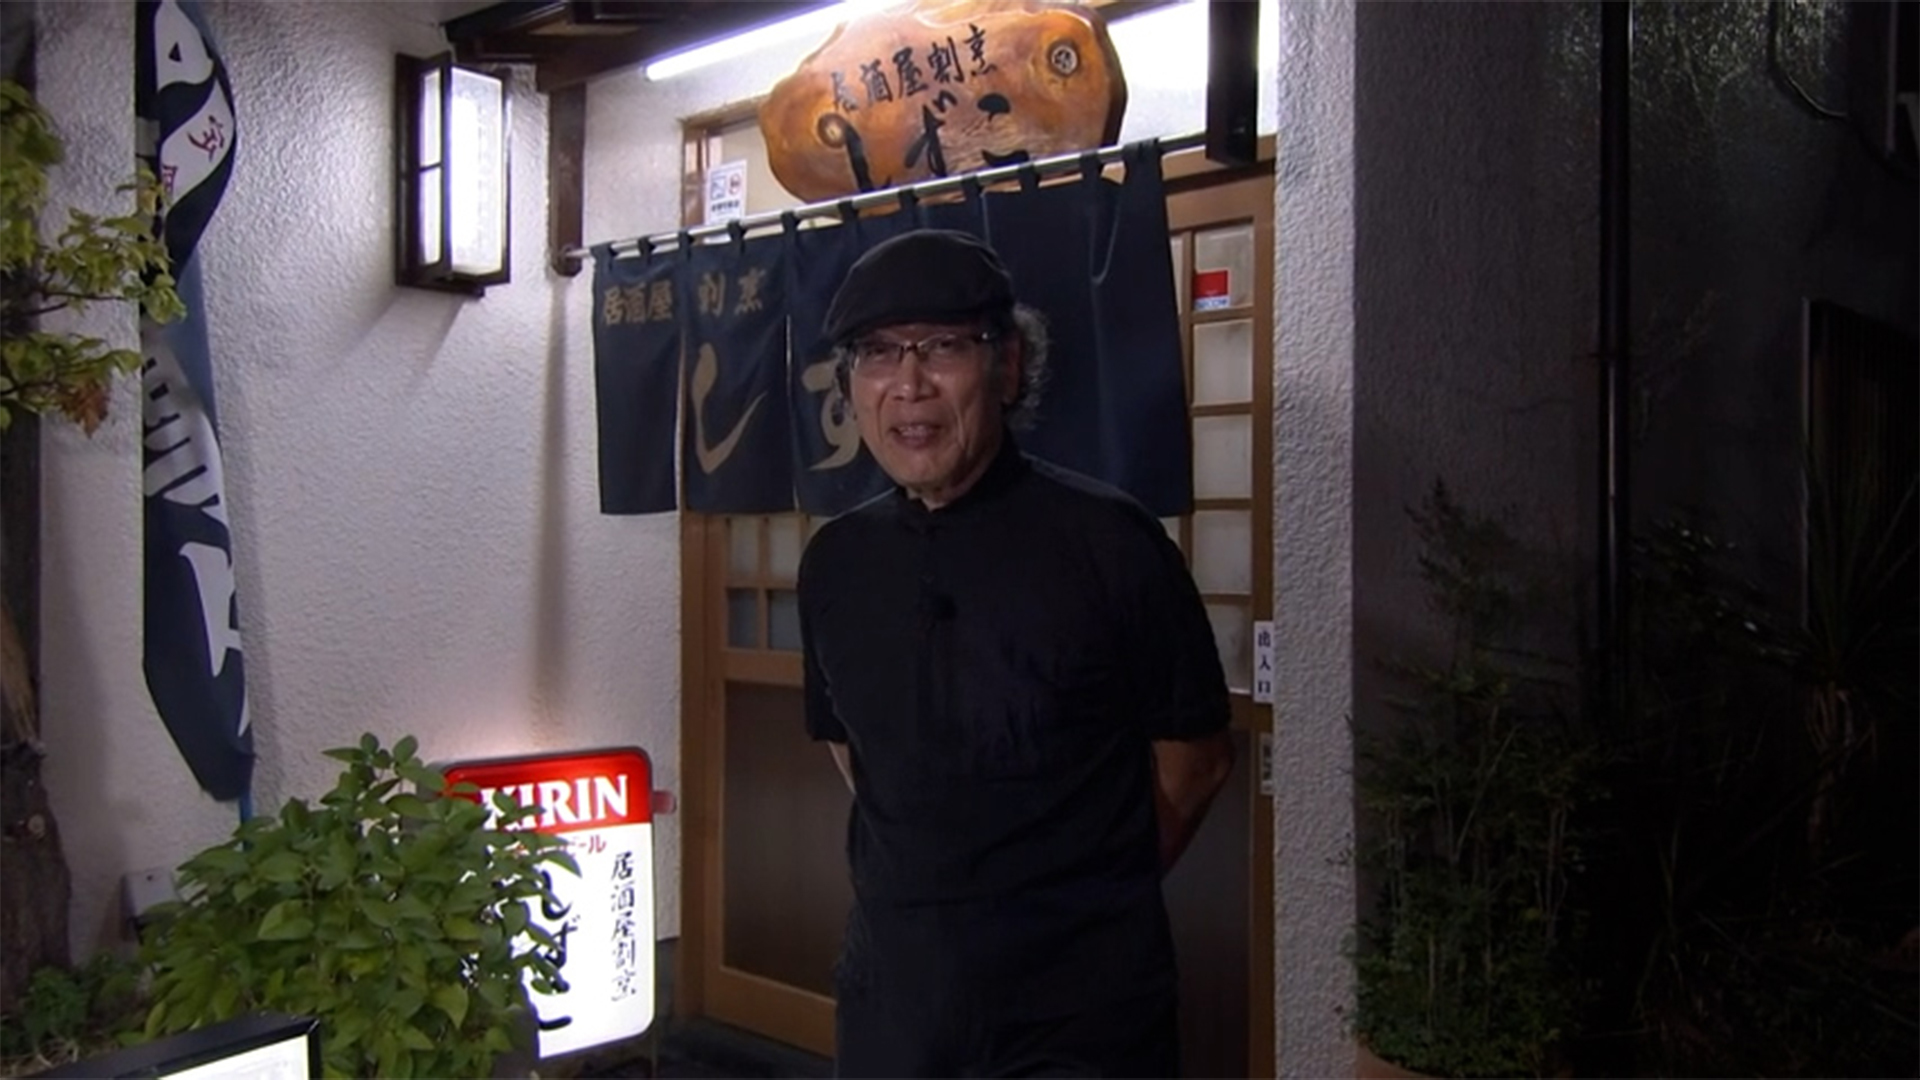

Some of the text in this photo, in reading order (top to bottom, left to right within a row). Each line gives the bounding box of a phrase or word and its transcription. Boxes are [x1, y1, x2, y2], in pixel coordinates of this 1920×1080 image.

[831, 23, 997, 113] 居酒屋割烹
[1257, 631, 1272, 694] 出入口
[480, 774, 628, 831] KIRIN
